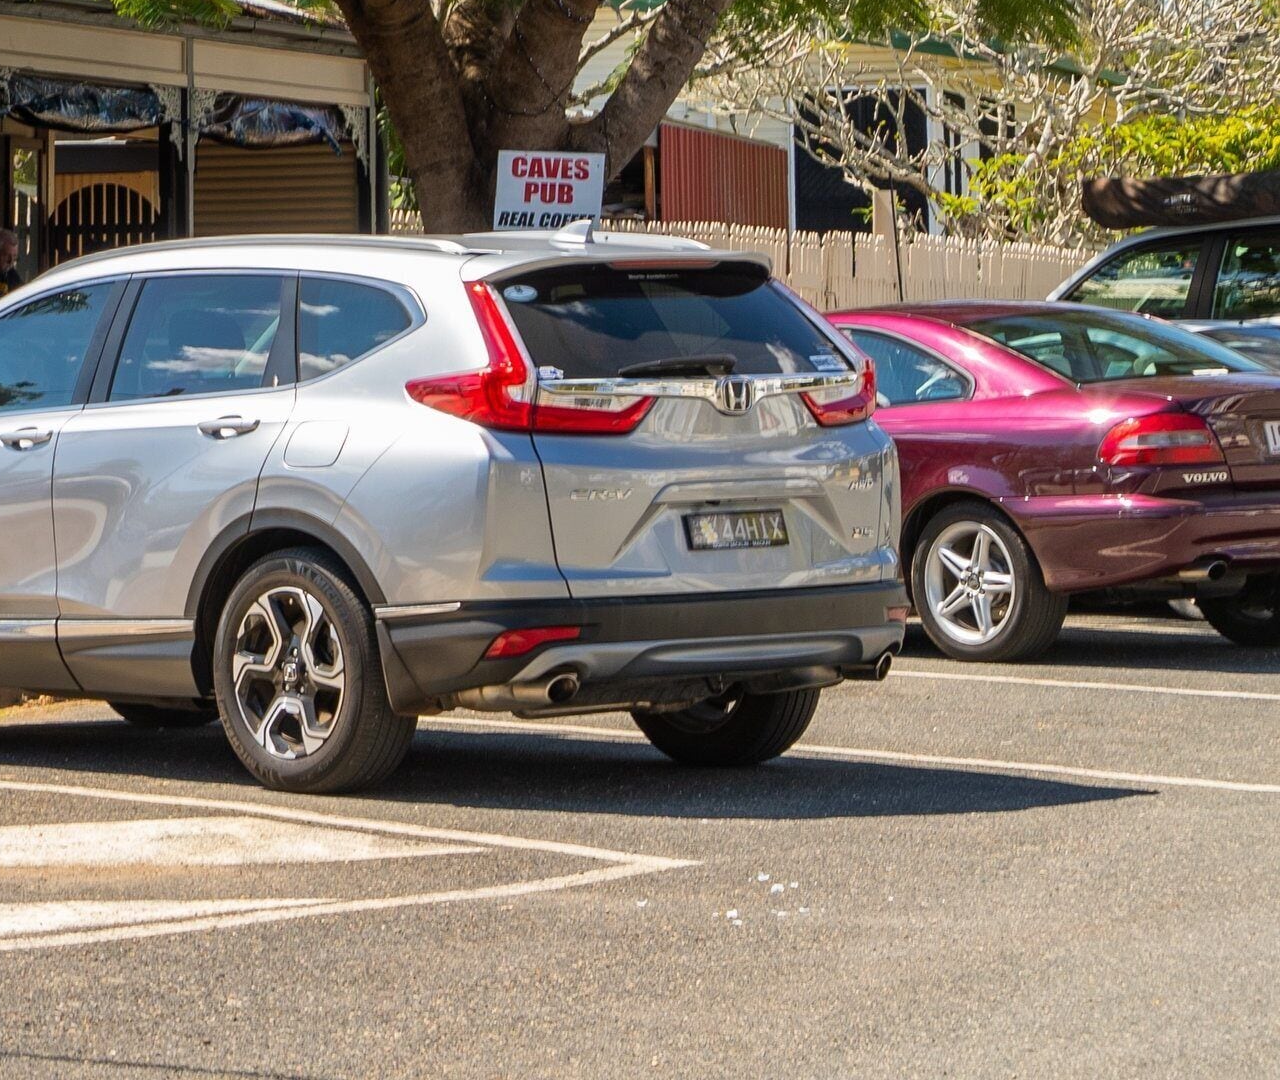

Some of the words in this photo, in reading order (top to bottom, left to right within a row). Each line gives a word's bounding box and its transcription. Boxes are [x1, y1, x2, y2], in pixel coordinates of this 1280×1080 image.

[511, 156, 590, 180] CAVES
[523, 181, 574, 204] PUB
[498, 210, 535, 227] REAL
[1182, 471, 1228, 484] VOLVO
